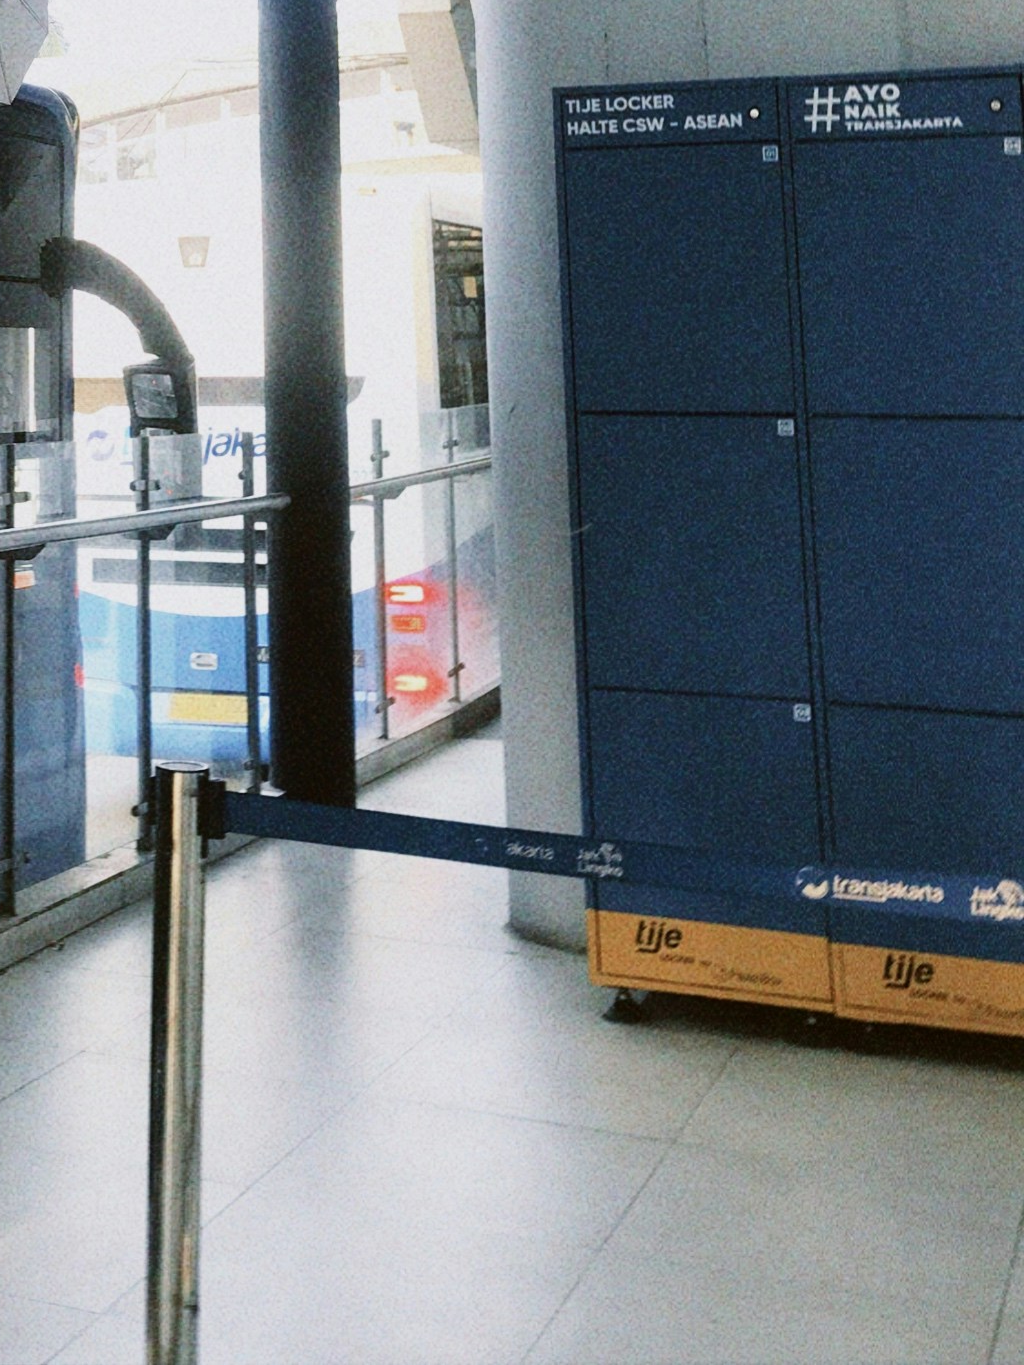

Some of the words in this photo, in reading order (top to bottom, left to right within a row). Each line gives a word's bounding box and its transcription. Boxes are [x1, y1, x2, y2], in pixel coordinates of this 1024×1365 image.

[844, 83, 901, 102] AYO
[565, 99, 602, 114] TIJE
[605, 94, 674, 112] LOCKER
[844, 103, 901, 119] NAIK
[567, 119, 618, 135] HALTE
[623, 117, 665, 132] CSW
[684, 113, 743, 130] ASEAN
[845, 116, 964, 132] TRANSJAKARTA
[635, 920, 683, 953] tije
[883, 954, 934, 989] tije
